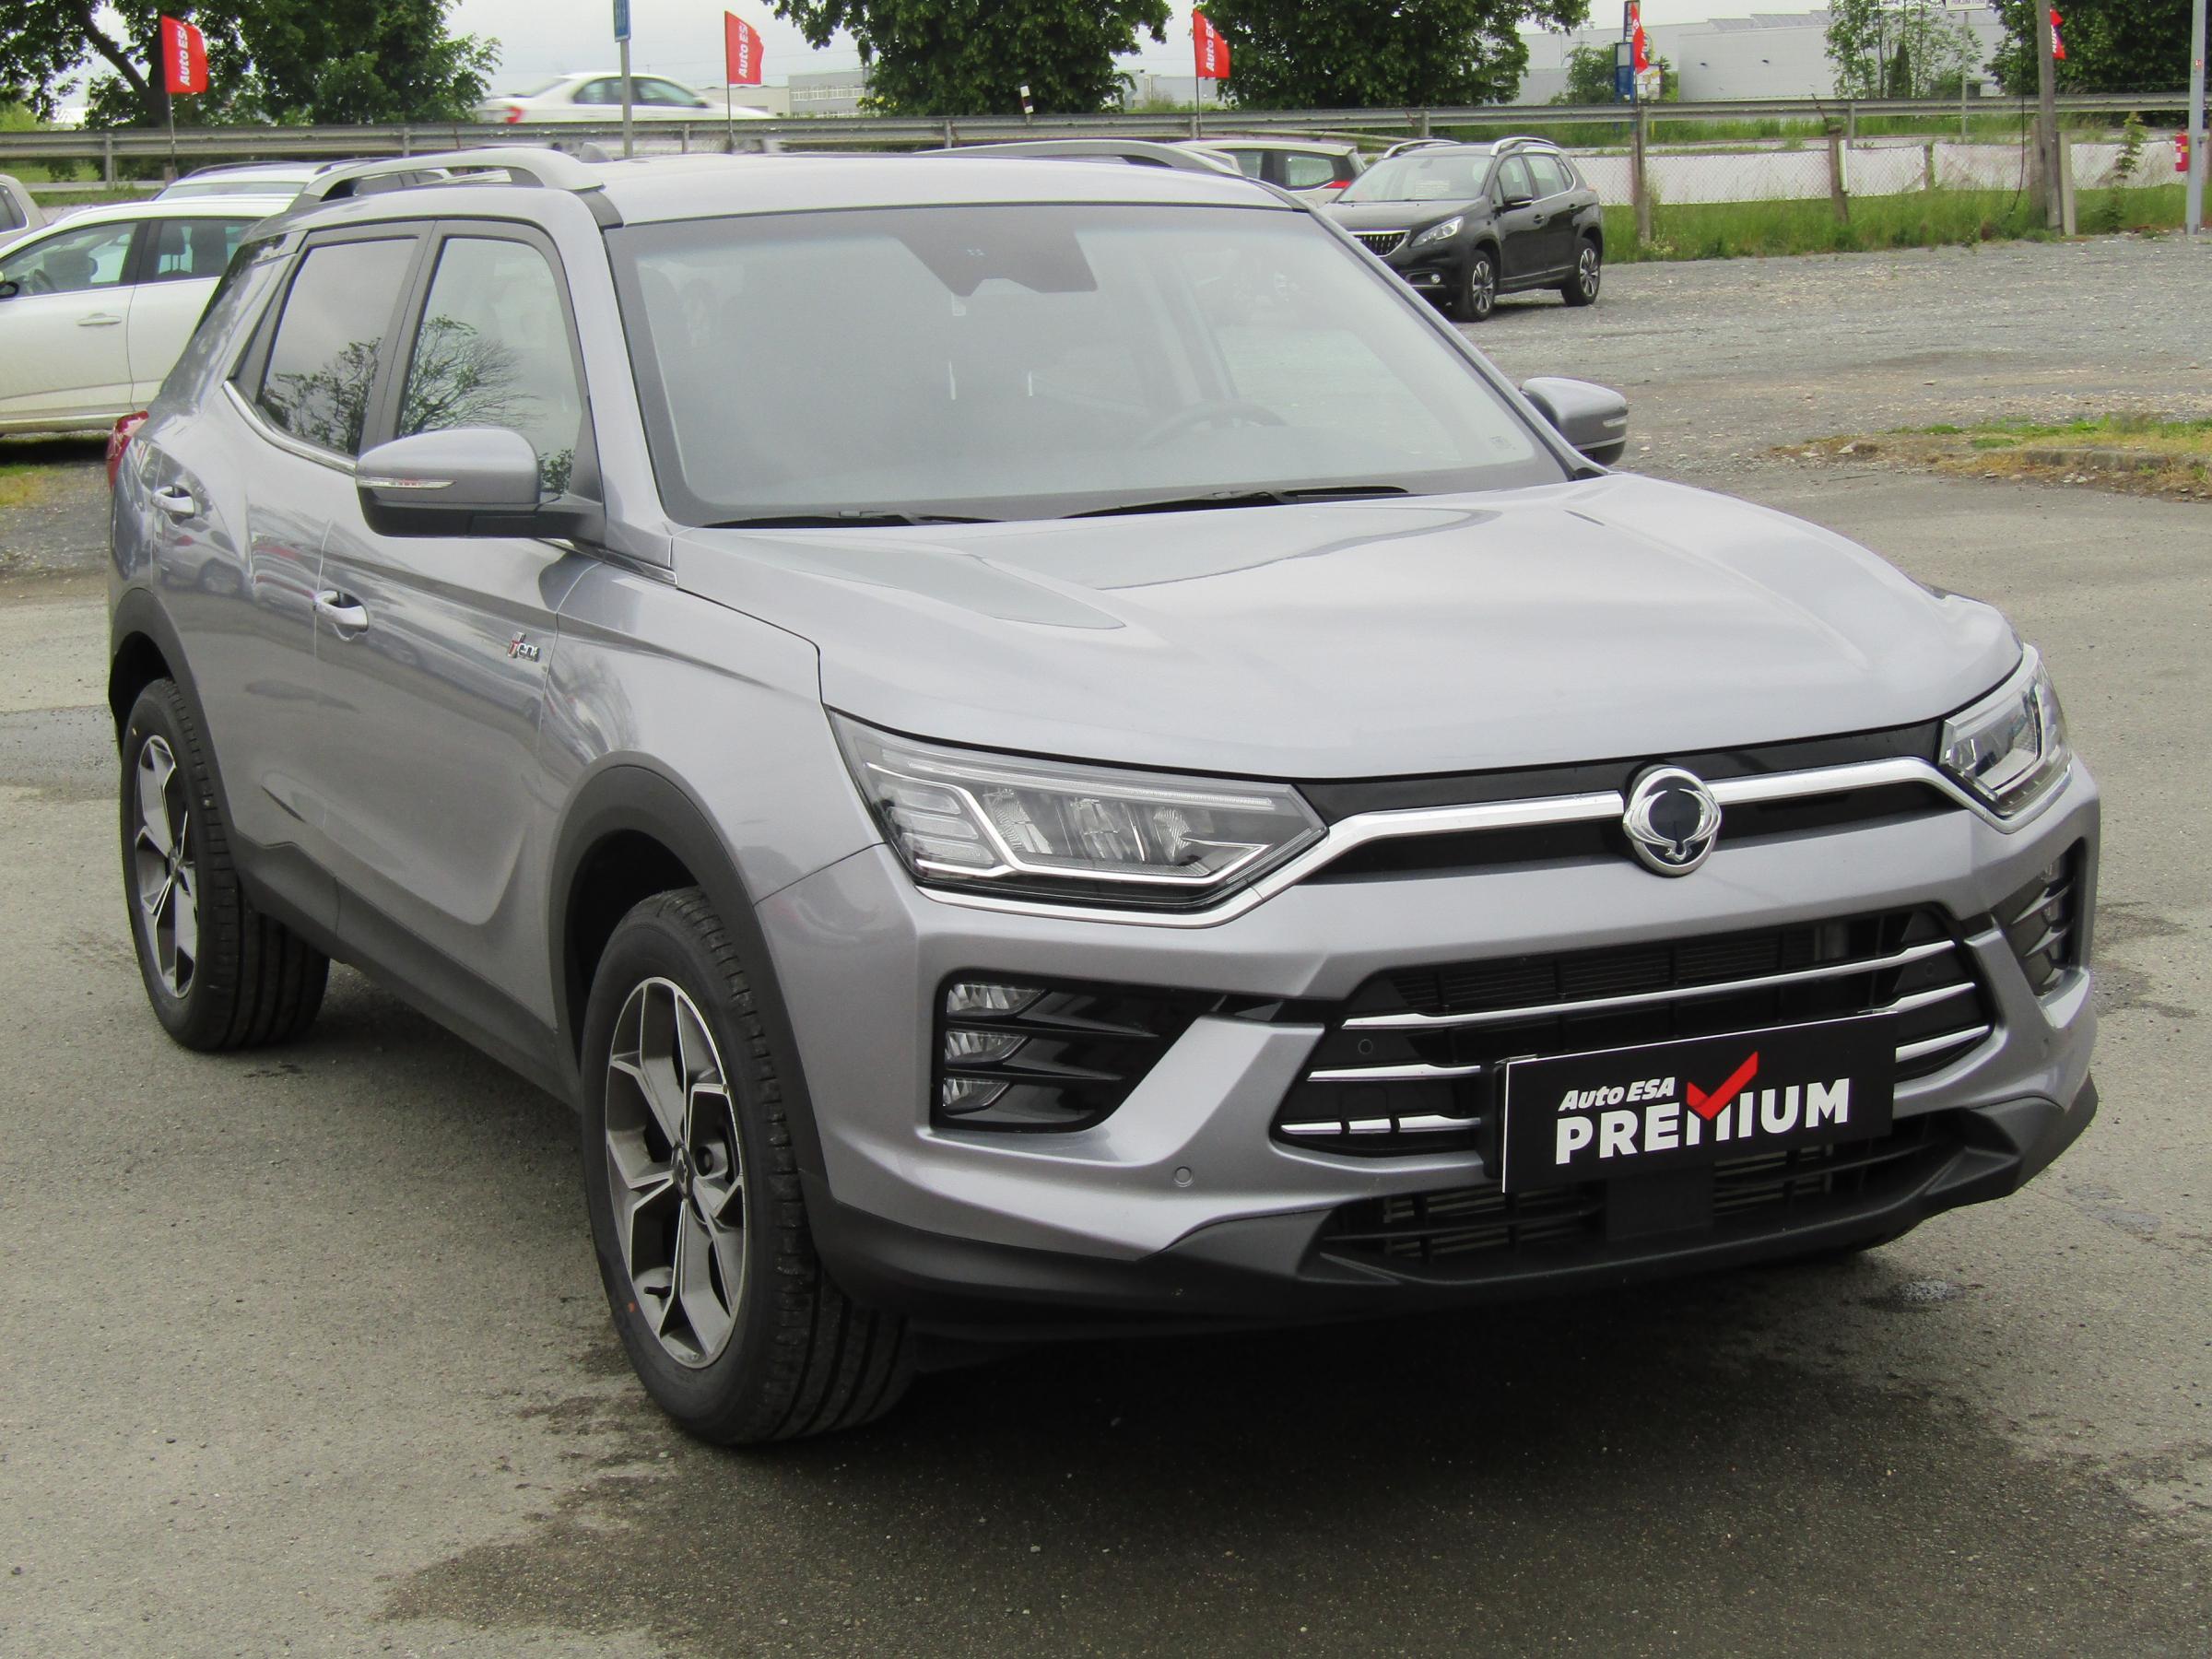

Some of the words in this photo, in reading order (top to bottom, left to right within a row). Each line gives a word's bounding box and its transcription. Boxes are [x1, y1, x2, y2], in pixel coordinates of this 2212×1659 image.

[179, 49, 191, 87] Auto
[738, 43, 748, 79] Auto
[1206, 41, 1215, 73] Auto
[1558, 1086, 1625, 1112] Auto
[1626, 1077, 1675, 1102] ESA
[1555, 1077, 1851, 1165] PREMIUM
